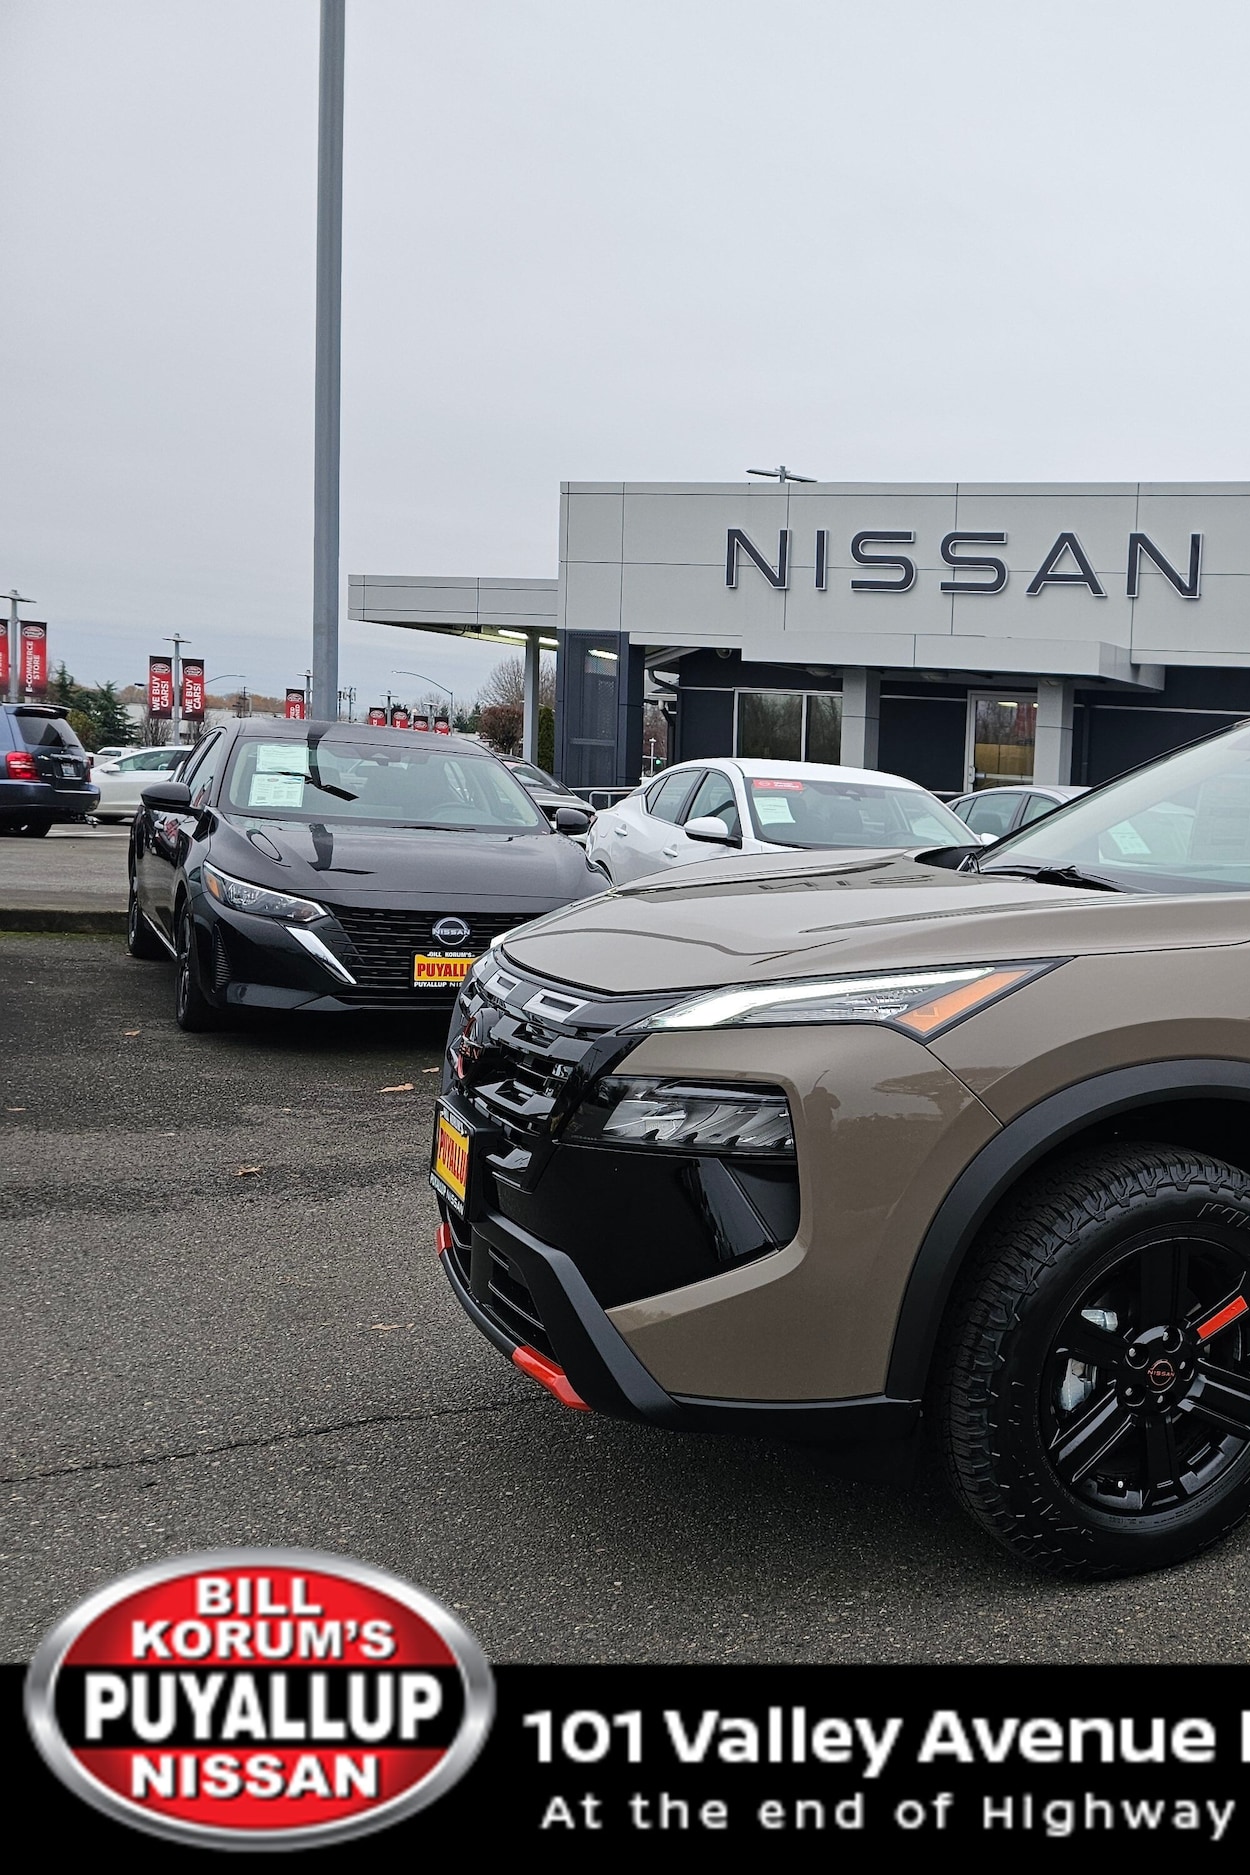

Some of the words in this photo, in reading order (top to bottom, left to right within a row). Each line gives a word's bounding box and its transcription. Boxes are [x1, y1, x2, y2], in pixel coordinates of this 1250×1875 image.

[724, 526, 1205, 600] NISSAN
[152, 675, 160, 694] BUY
[160, 680, 169, 708] CARS!
[185, 677, 193, 697] BUY
[152, 696, 160, 711] WE
[185, 699, 193, 713] WE
[193, 683, 201, 710] CARS!
[438, 1127, 469, 1188] PUYALLU
[1147, 1368, 1175, 1377] NISSAN
